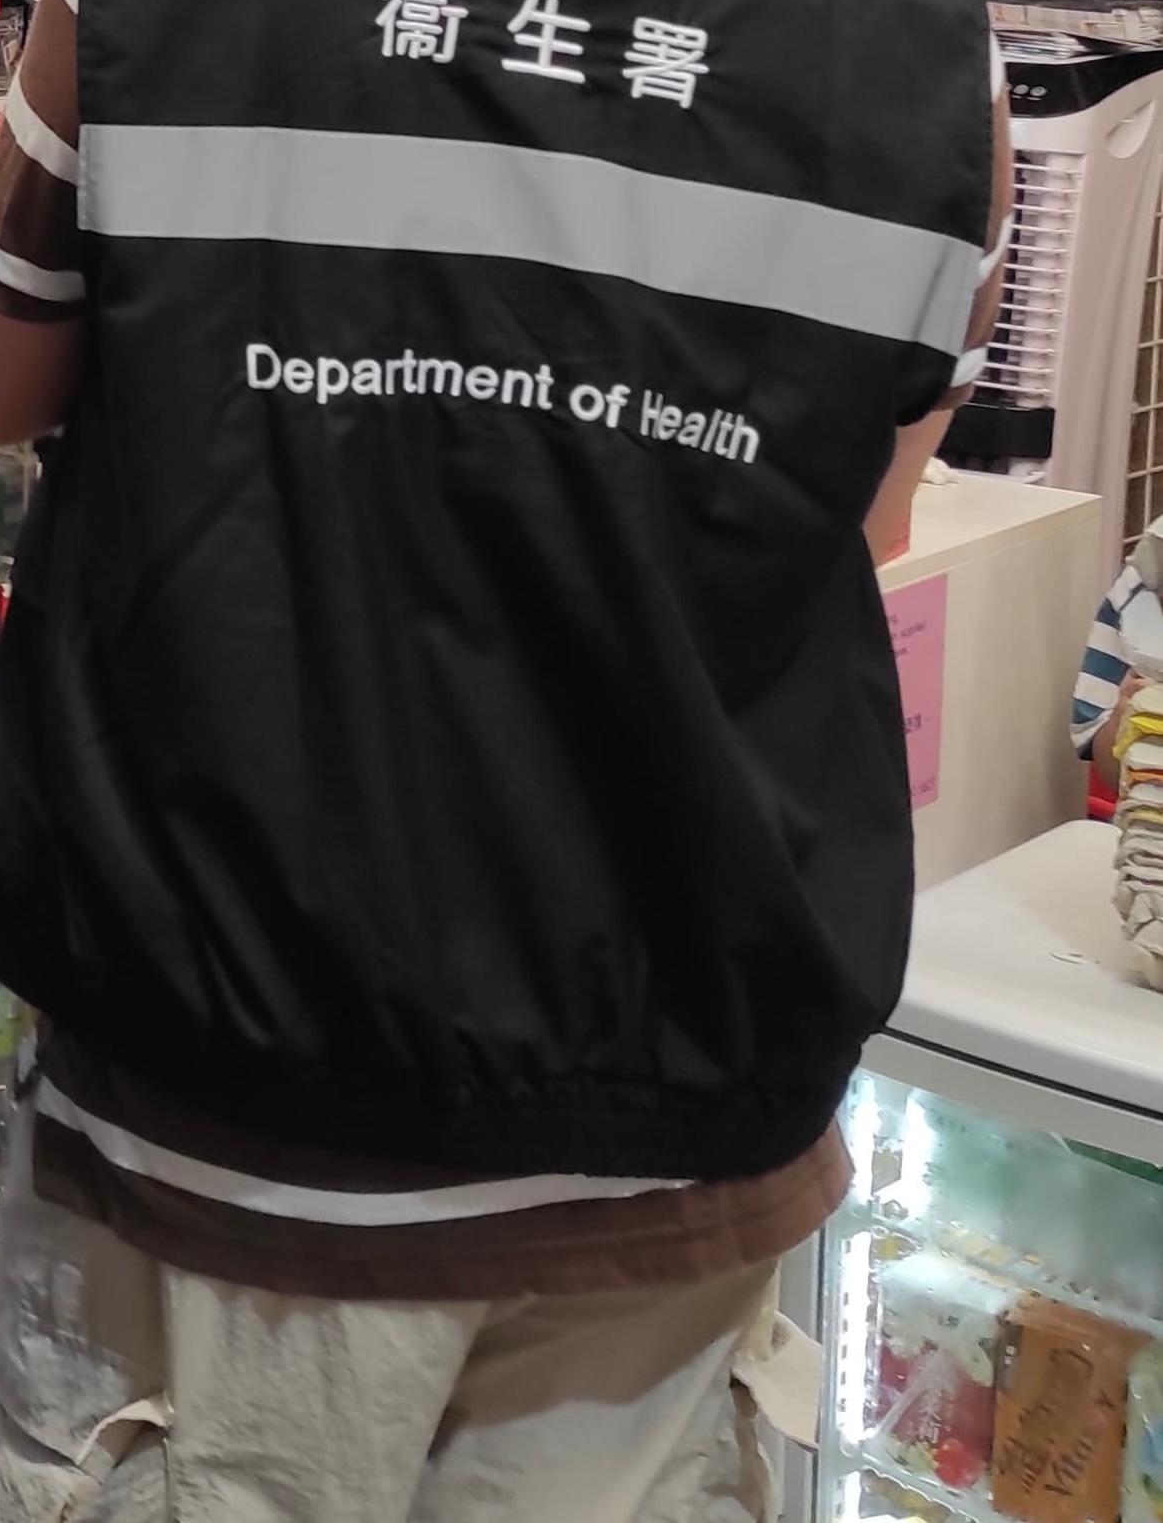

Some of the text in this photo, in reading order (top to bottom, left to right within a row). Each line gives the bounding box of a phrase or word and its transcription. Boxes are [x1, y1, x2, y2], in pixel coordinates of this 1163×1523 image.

[245, 343, 761, 464] Department of Health
